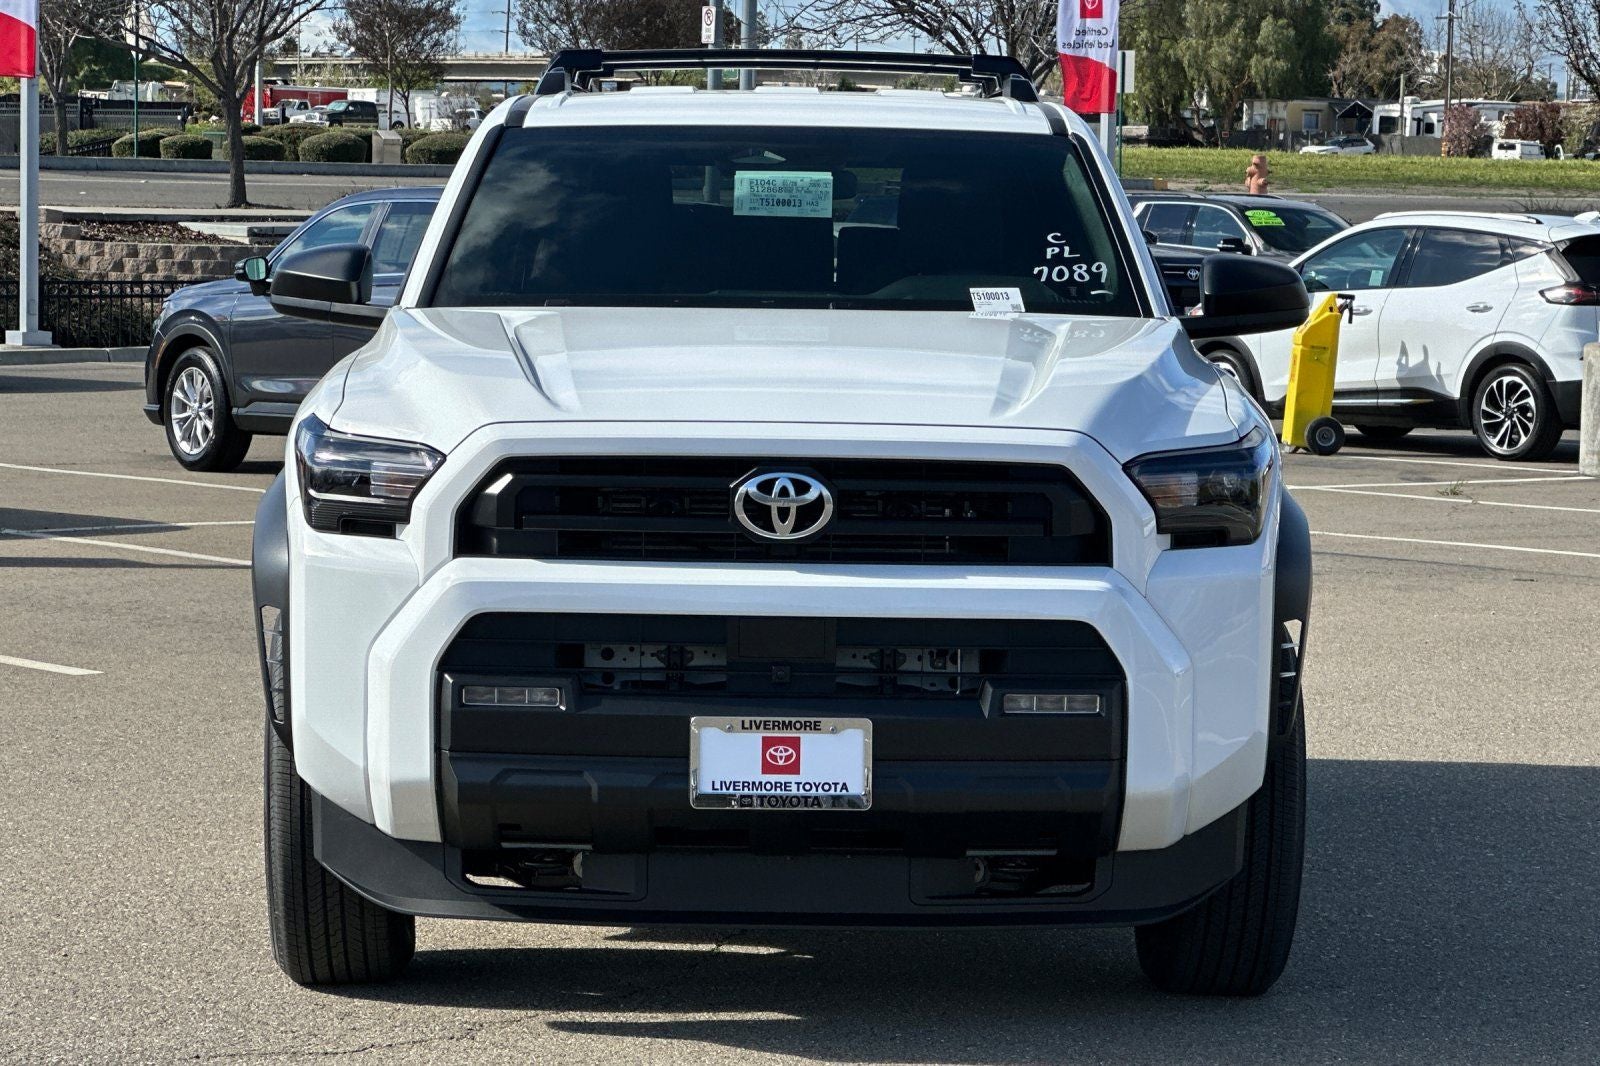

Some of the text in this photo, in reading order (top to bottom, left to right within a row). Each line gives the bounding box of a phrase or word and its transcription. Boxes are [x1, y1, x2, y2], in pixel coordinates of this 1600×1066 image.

[759, 198, 803, 208] T5100013
[1046, 232, 1067, 244] C
[1046, 245, 1081, 259] PL
[1033, 261, 1108, 283] 7089
[970, 291, 1010, 301] T5100013
[741, 720, 822, 732] LIVERMORE
[711, 780, 850, 793] LIVERMORE TOYOTA
[758, 794, 823, 808] TOYOTA
